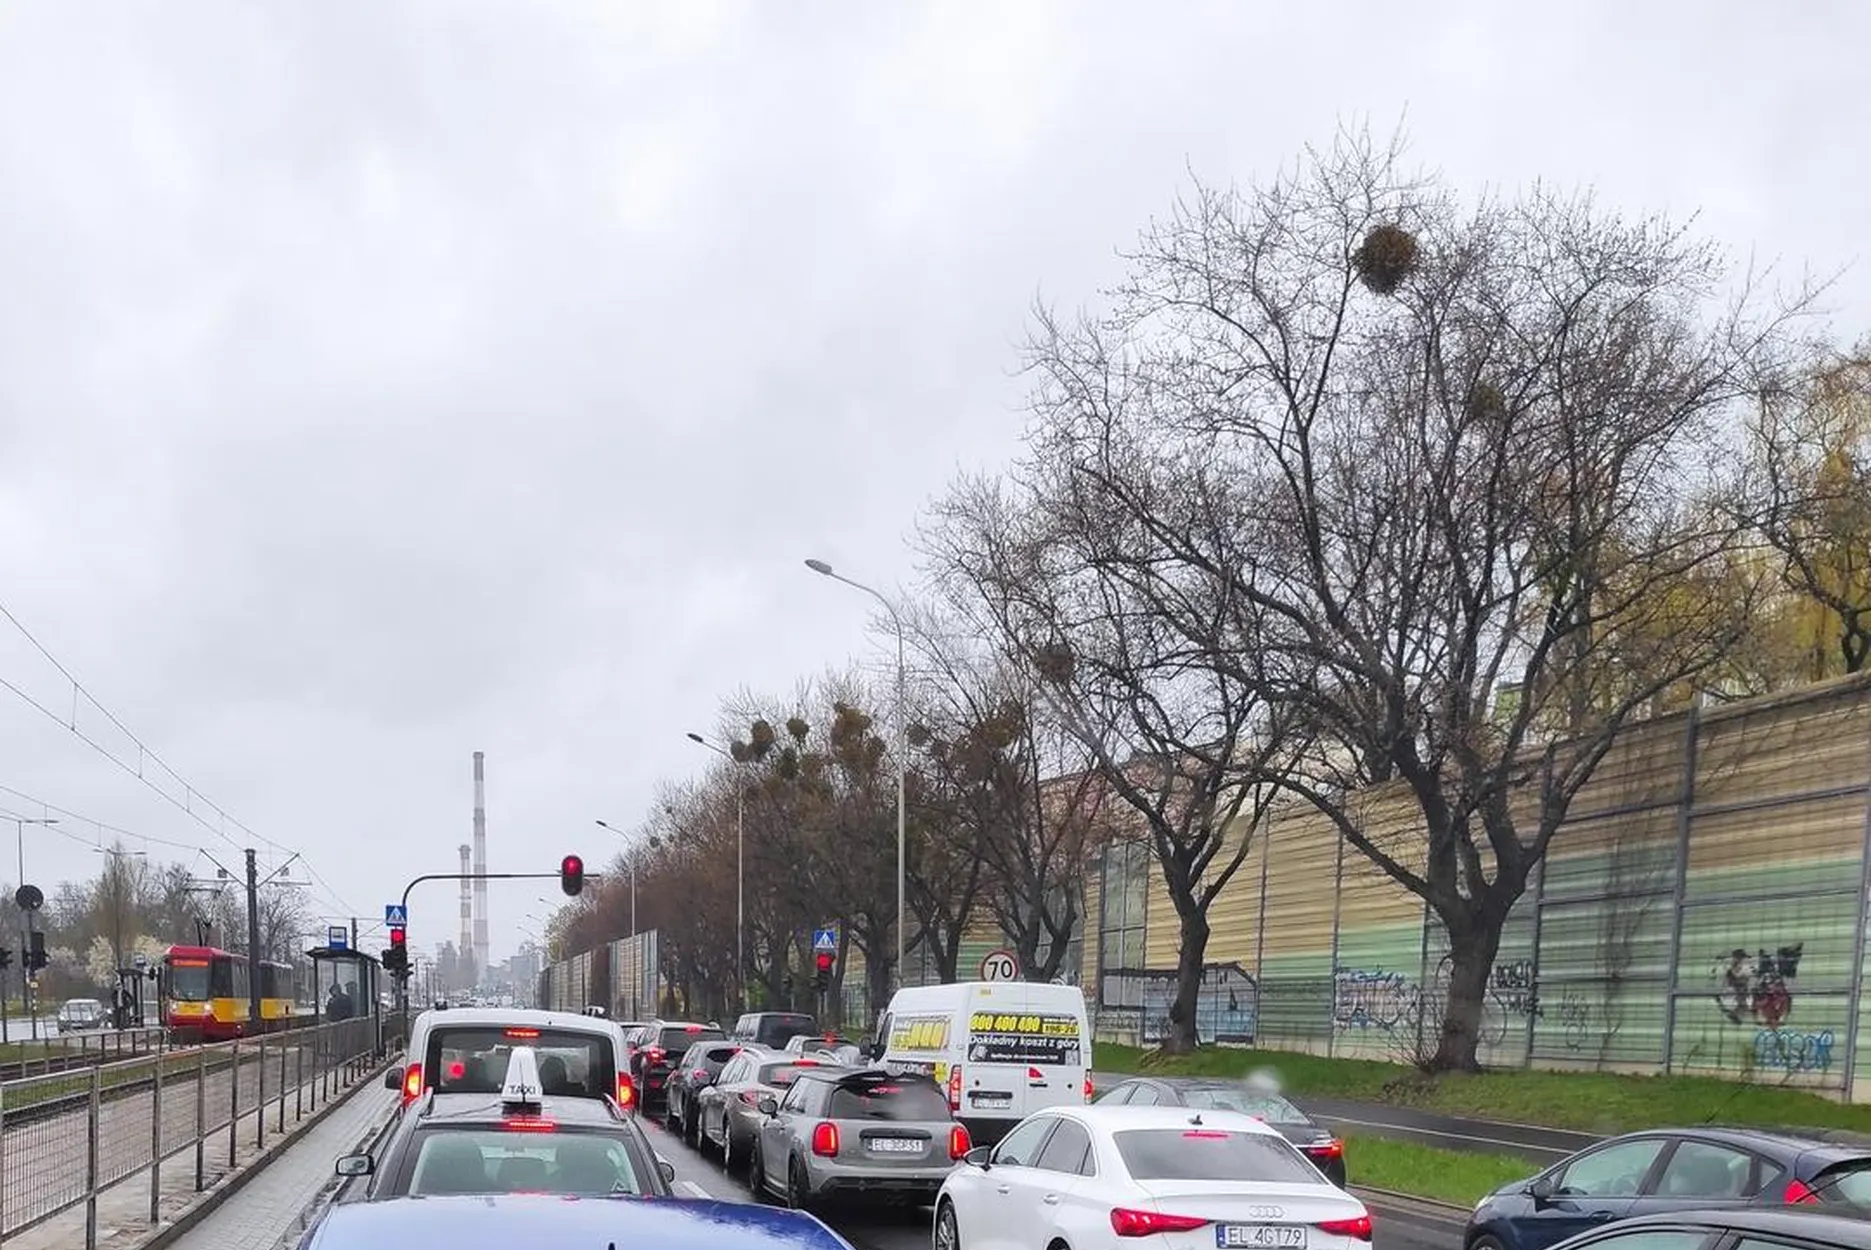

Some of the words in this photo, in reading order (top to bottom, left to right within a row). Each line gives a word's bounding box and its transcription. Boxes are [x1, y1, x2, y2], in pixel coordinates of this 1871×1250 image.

[988, 960, 1012, 980] 70
[509, 1085, 536, 1095] TAXI
[1228, 1228, 1248, 1244] EL
[1255, 1228, 1301, 1245] 4GT79
